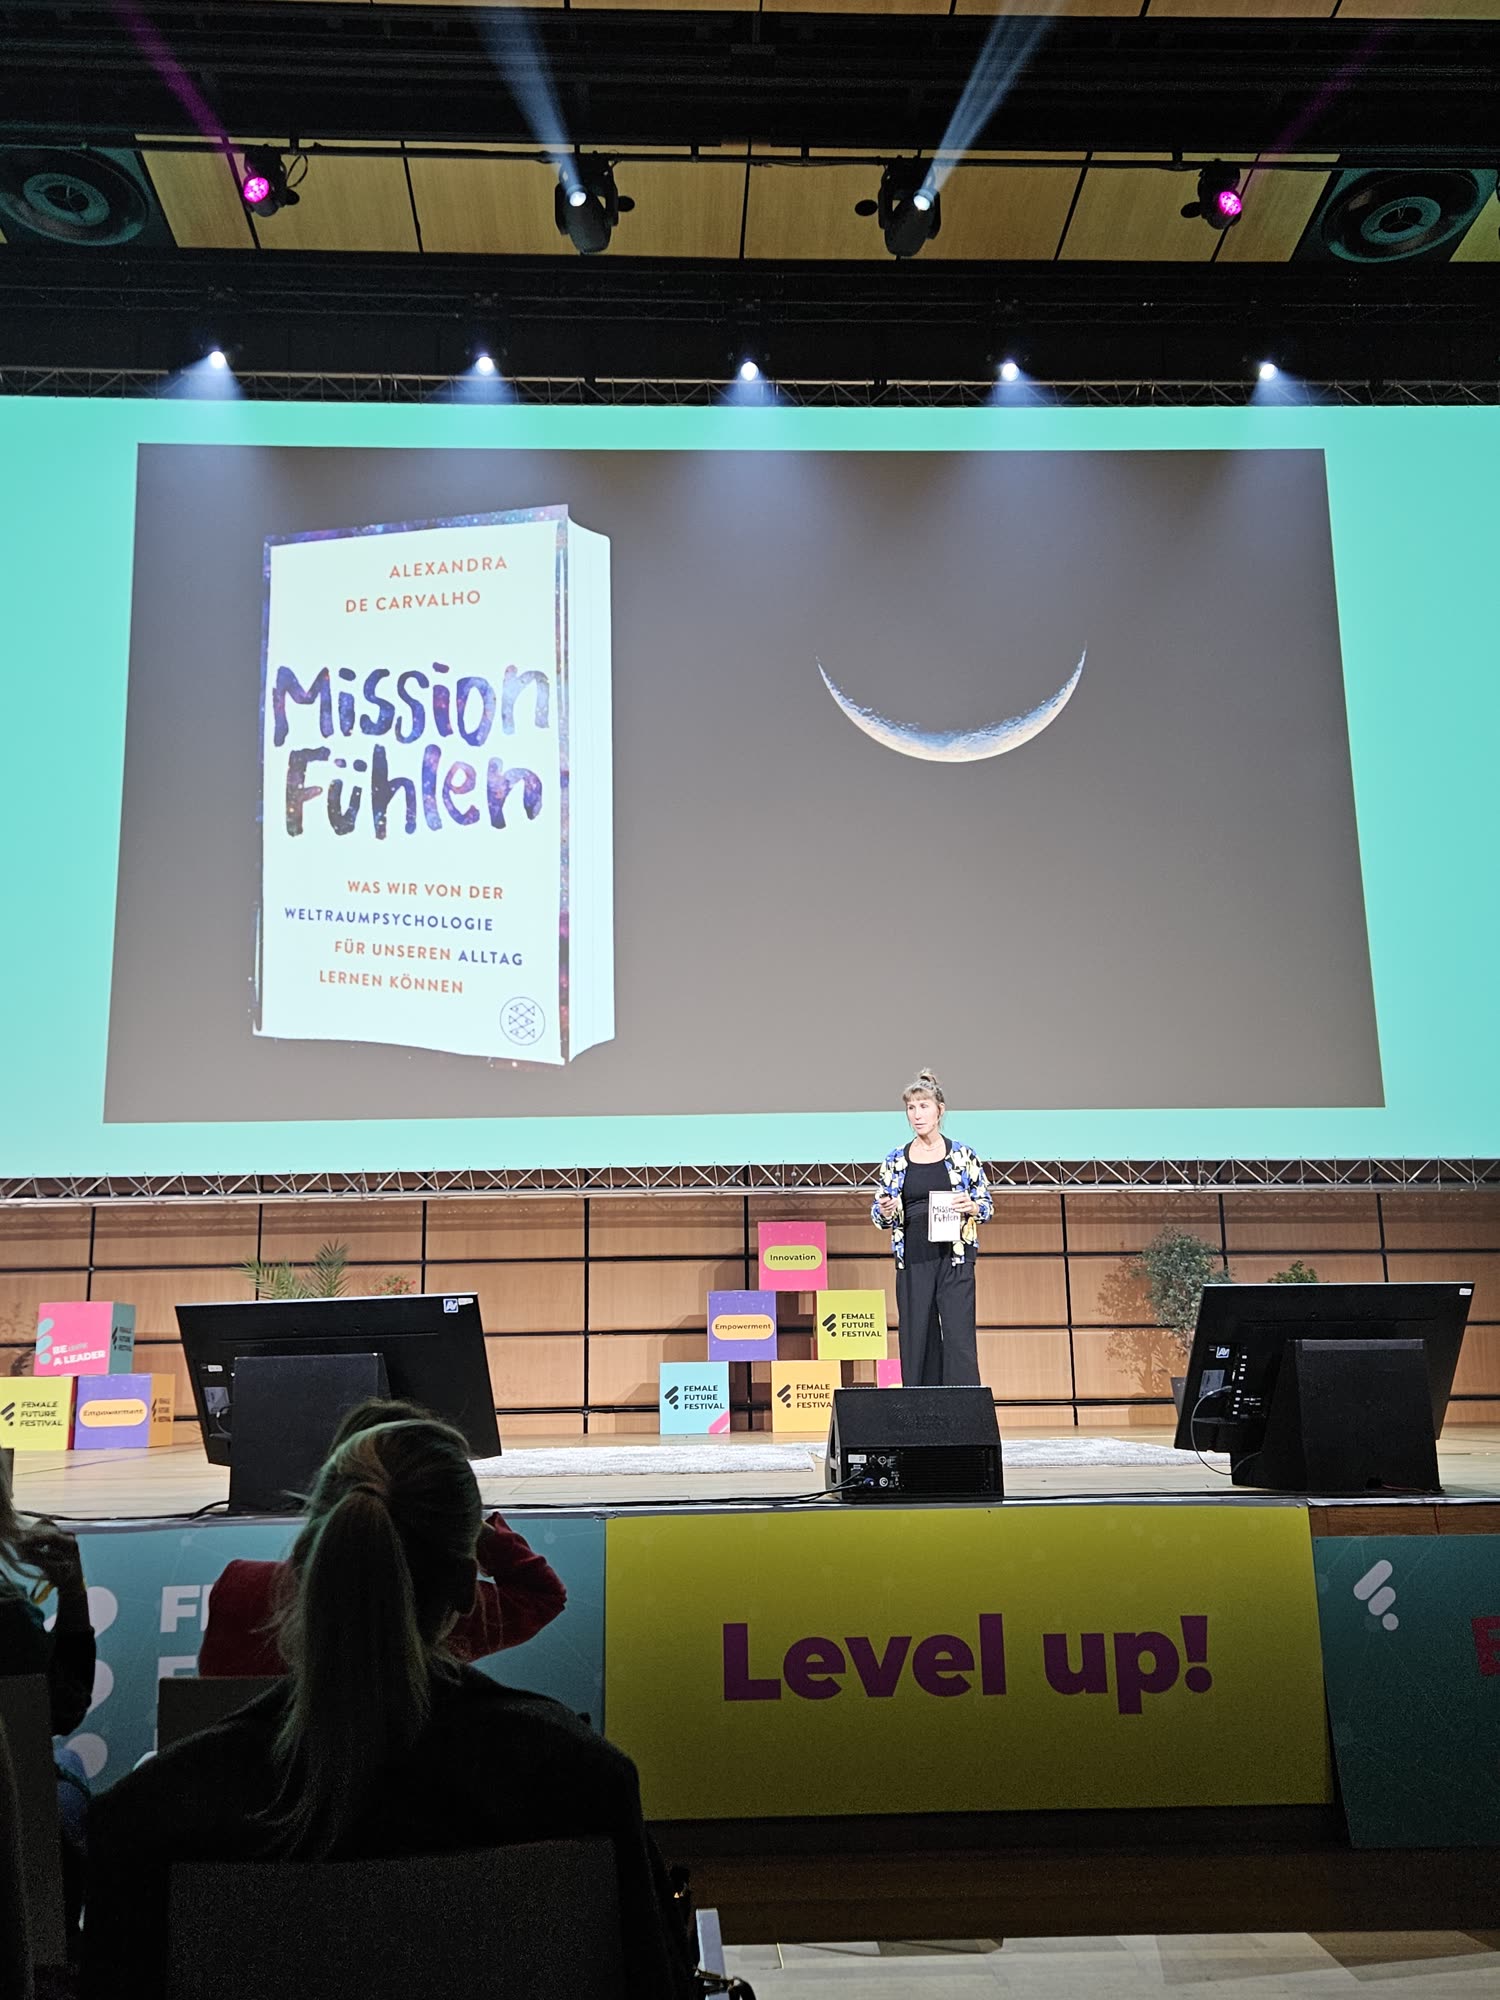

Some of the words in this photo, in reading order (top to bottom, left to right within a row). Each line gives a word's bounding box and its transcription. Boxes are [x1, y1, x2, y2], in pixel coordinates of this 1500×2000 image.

[389, 555, 508, 579] ALEXANDRA
[345, 598, 369, 613] DE
[375, 590, 481, 611] CARVALHO
[272, 661, 550, 747] Mission
[285, 743, 543, 840] Fühlen
[347, 880, 381, 894] WAS
[387, 882, 418, 896] WIR
[424, 884, 462, 898] VON
[469, 886, 504, 900] DER
[284, 906, 494, 932] WELTRAUMPSYCHOLOGIE
[334, 938, 366, 955] FÜR
[372, 943, 452, 961] UNSEREN
[457, 949, 524, 966] ALLTAG
[319, 970, 383, 988] LERNEN
[389, 973, 464, 994] KÖNNEN
[769, 1253, 816, 1262] Innovation
[715, 1322, 771, 1331] Empowerment
[52, 1344, 68, 1355] BE
[53, 1357, 63, 1367] A
[63, 1350, 106, 1364] LEADER
[684, 1384, 718, 1392] FEMALE
[796, 1383, 831, 1391] FEMALE
[796, 1392, 830, 1400] FUTURE
[796, 1401, 833, 1409] FESTIVA
[20, 1419, 63, 1427] FESTIVAL
[721, 1612, 1008, 1702] Level
[1042, 1613, 1213, 1716] up!
